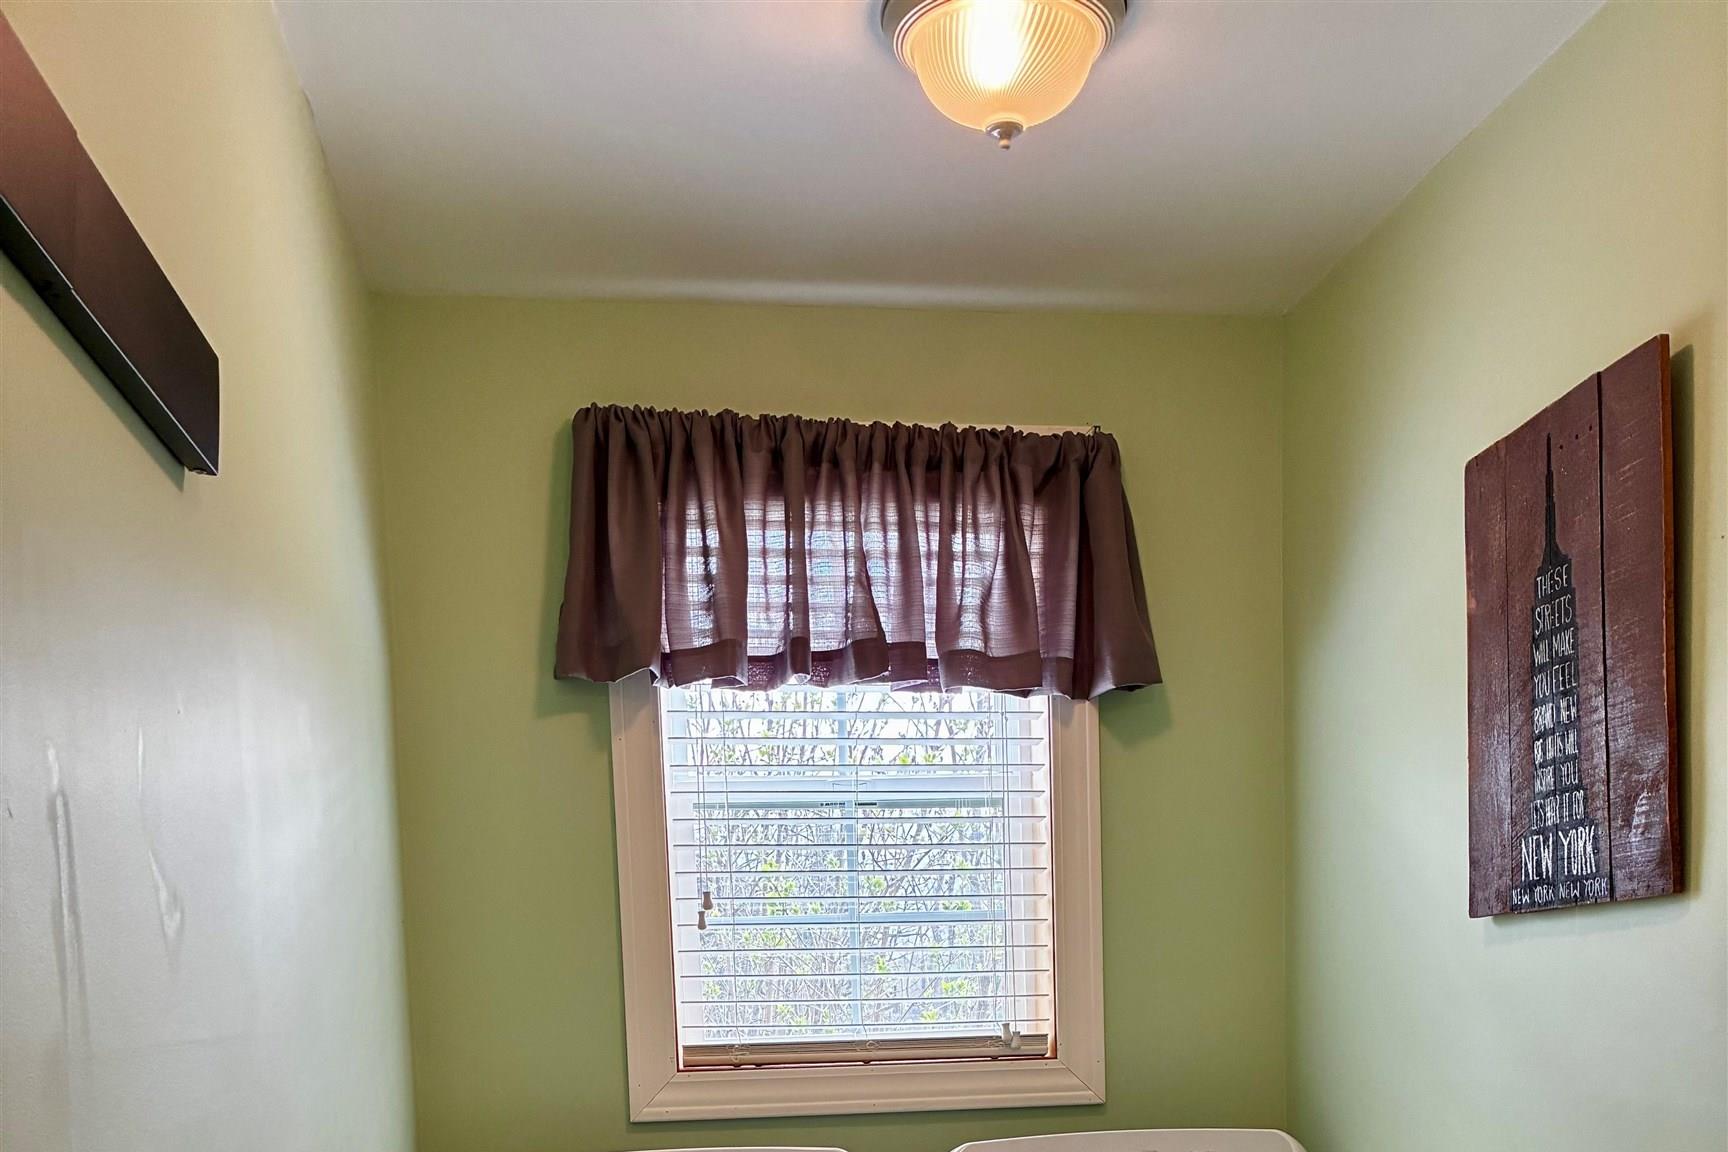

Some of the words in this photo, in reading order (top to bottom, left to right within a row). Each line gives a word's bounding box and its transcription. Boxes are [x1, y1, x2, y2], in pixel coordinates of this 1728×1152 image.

[1536, 563, 1569, 599] THESE
[1535, 594, 1573, 636] STREETS
[1532, 639, 1550, 667] WILL
[1552, 627, 1575, 658] MAKE
[1533, 670, 1550, 700] YOU
[1552, 661, 1577, 693] FEEL
[1533, 702, 1556, 734] BRAND
[1560, 694, 1577, 725] NEW
[1565, 729, 1579, 755] WILL
[1560, 759, 1578, 786] YOU
[1545, 794, 1560, 827] HEAR
[1563, 792, 1570, 823] IT
[1572, 789, 1585, 820] FOR
[1520, 830, 1553, 883] NEW
[1558, 825, 1597, 877] YORK
[1512, 889, 1530, 905] NEW
[1534, 885, 1555, 904] YORK
[1559, 881, 1580, 899] NEW
[1583, 877, 1608, 896] YORK
